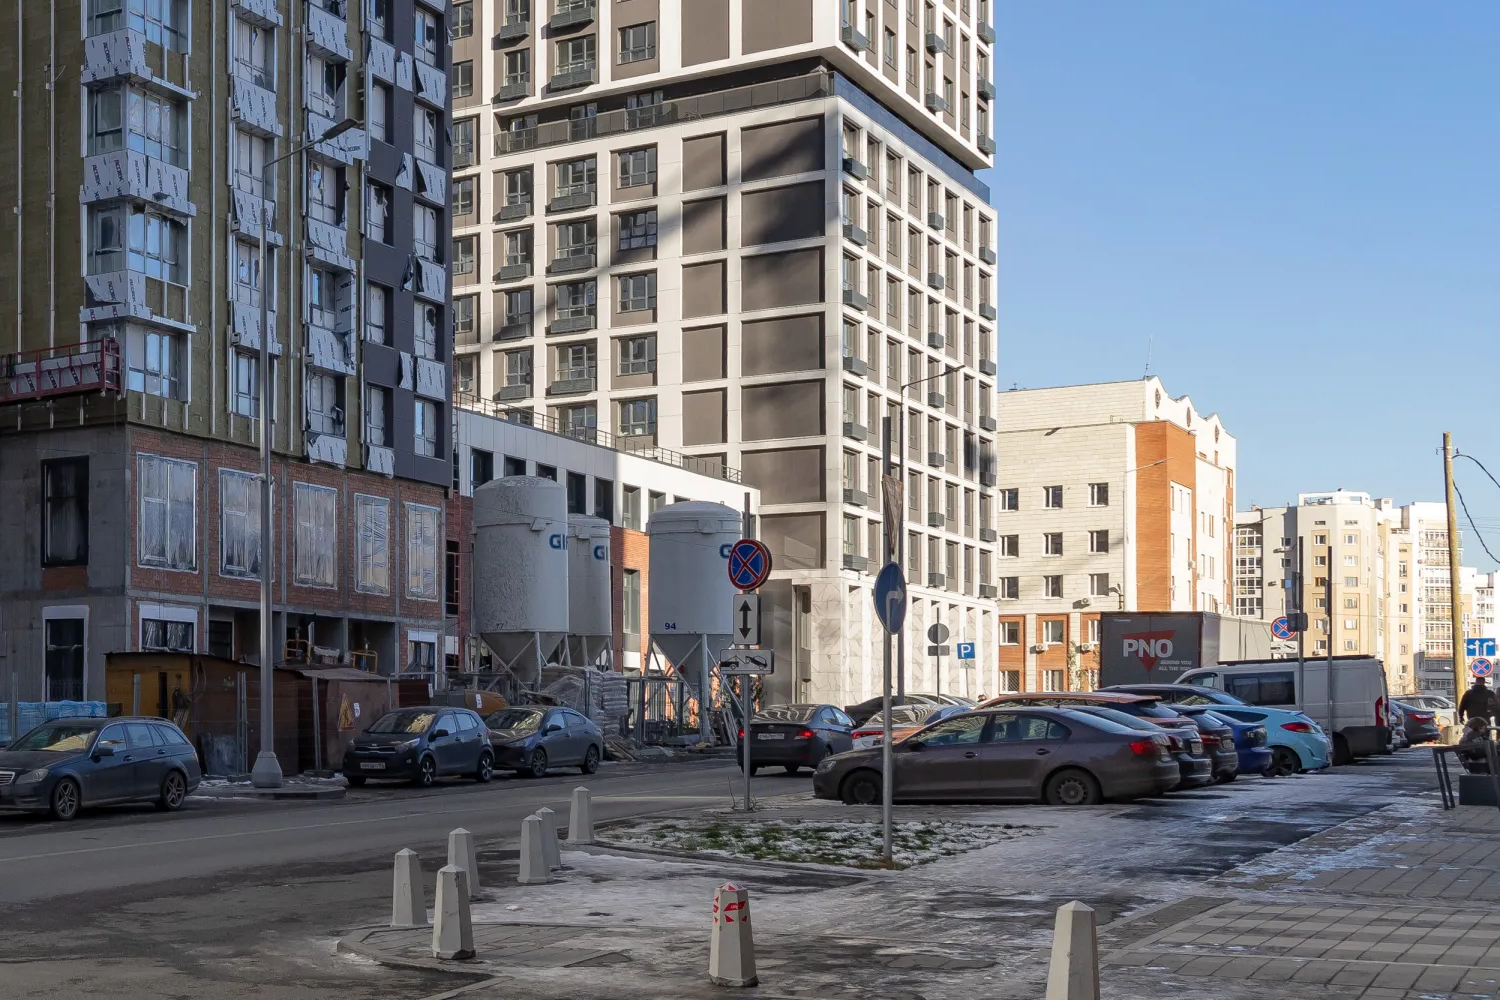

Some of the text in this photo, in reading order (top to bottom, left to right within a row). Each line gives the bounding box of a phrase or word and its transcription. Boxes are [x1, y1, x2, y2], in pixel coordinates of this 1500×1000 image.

[664, 622, 676, 631] 94
[960, 644, 971, 658] P
[1123, 639, 1174, 658] PNO
